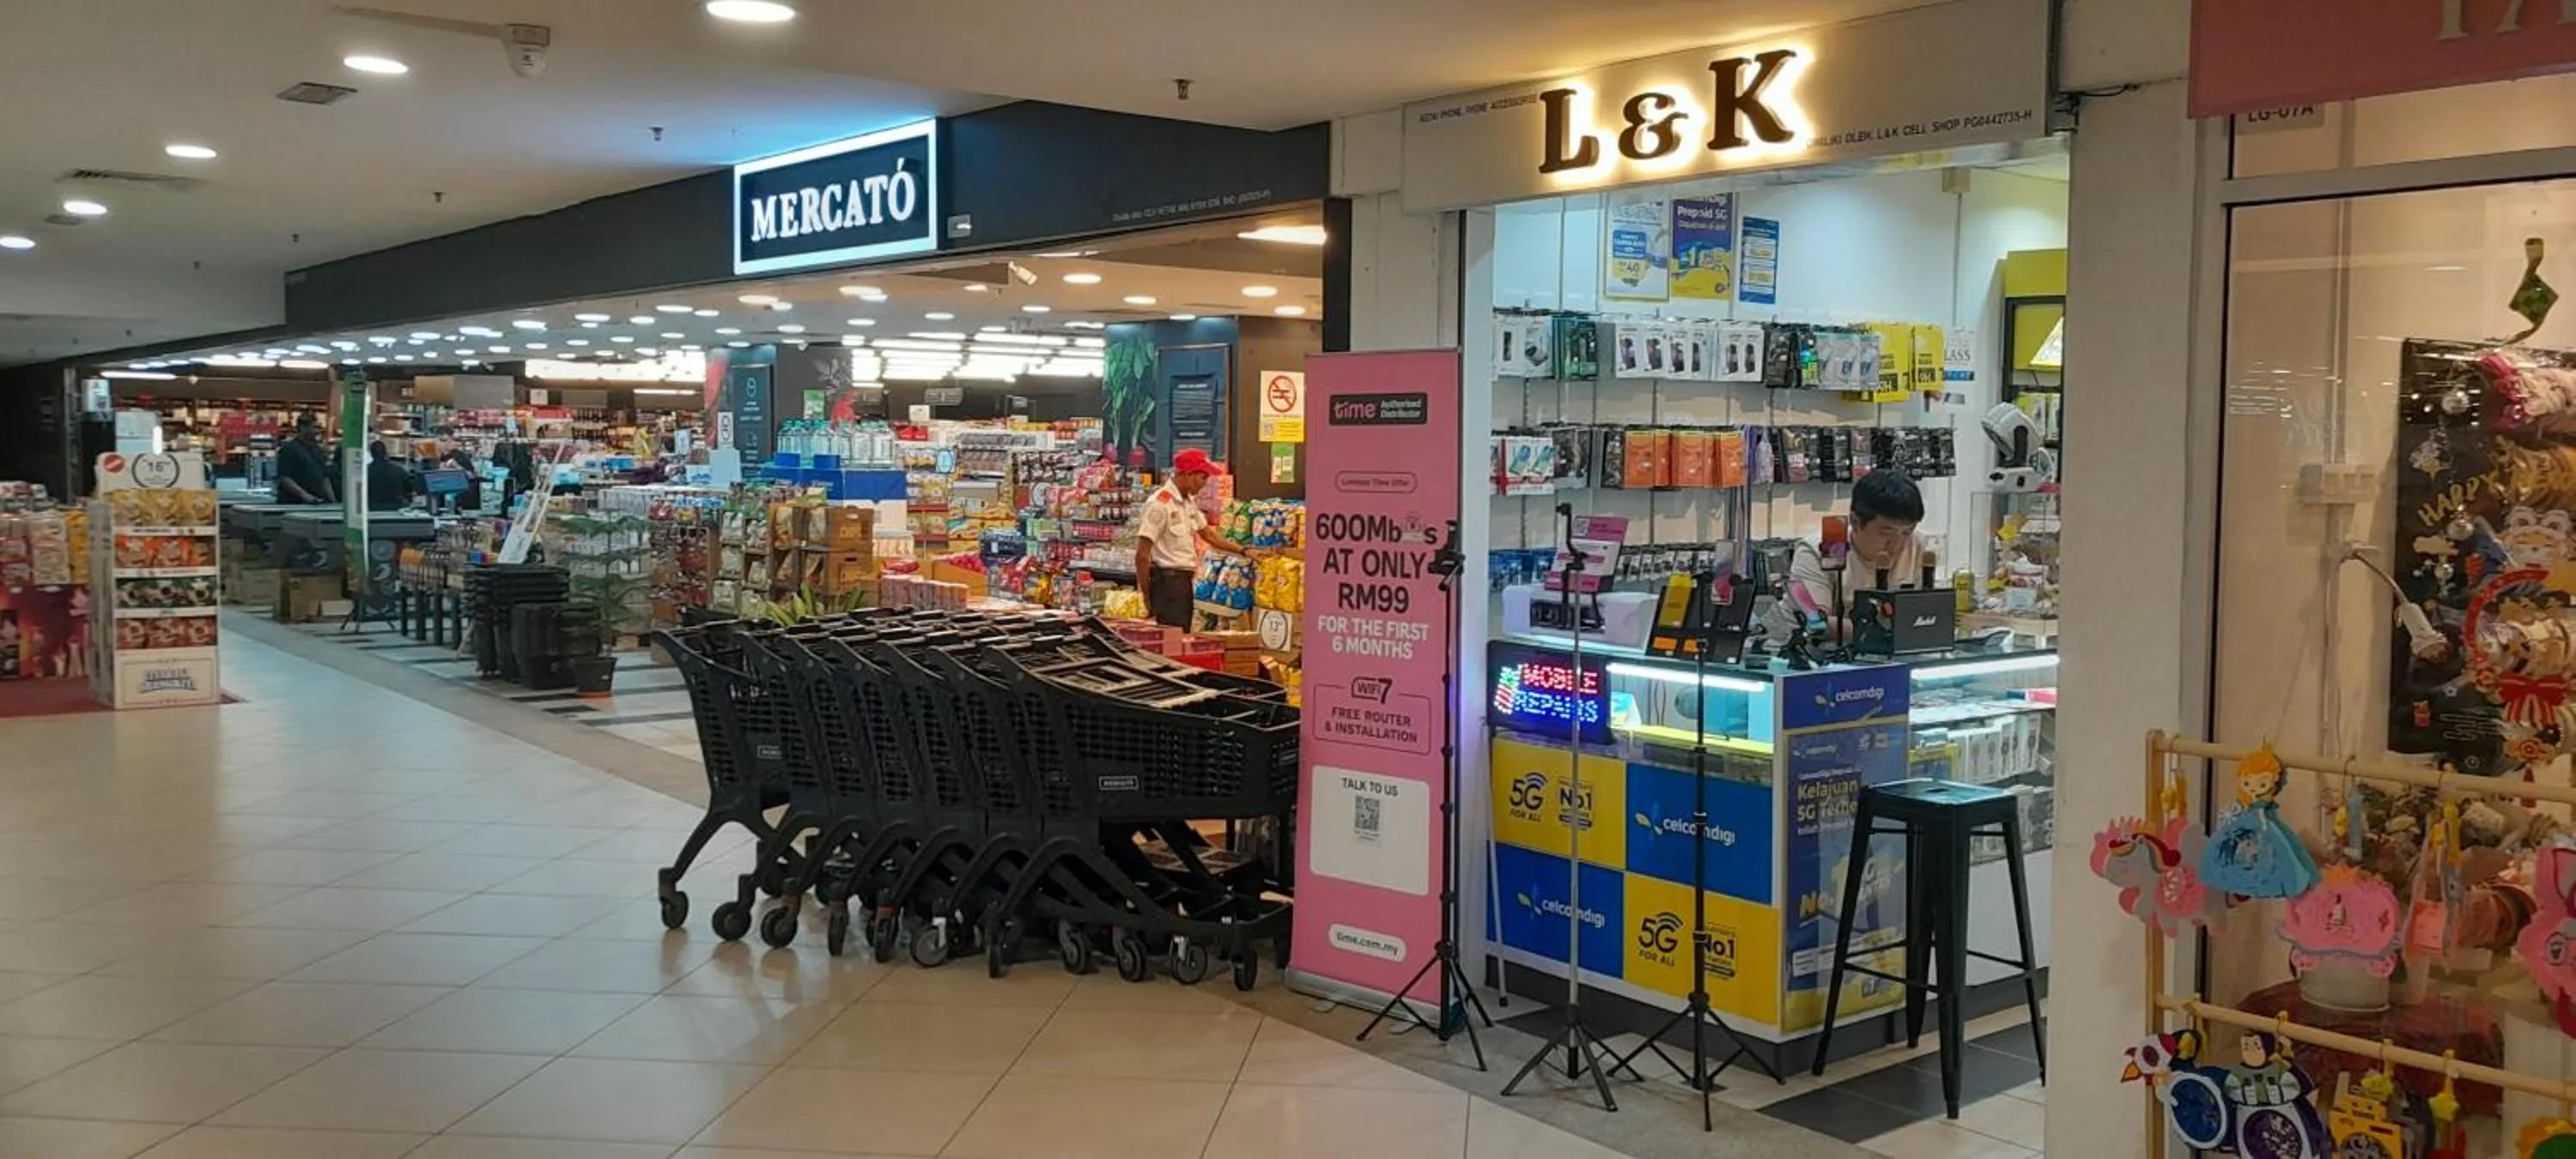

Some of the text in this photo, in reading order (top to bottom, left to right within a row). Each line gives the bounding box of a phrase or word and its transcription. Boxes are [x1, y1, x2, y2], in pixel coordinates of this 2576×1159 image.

[1903, 125, 1926, 137] CELL
[1931, 119, 1960, 133] SHOP
[750, 157, 916, 242] MERCATÓ
[1944, 349, 1971, 361] LASS
[1334, 401, 1376, 419] time
[1316, 513, 1437, 544] 600Mbs
[1322, 548, 1427, 580] AT ONLY
[1338, 583, 1409, 614] RM99
[1318, 616, 1430, 641] FOR THE FIRST
[1332, 636, 1413, 659] 6 MONTHS
[1523, 663, 1598, 694] MOBIE
[1332, 707, 1412, 727] FREE ROUTER
[1325, 720, 1417, 743] & INSTALLATION
[1342, 777, 1399, 797] TALK TO US
[1510, 778, 1544, 810] 5G
[1797, 778, 1858, 802] Kelajuan
[1797, 804, 1816, 822] 5G
[1638, 918, 1679, 953] 5G
[1638, 949, 1658, 961] FOR
